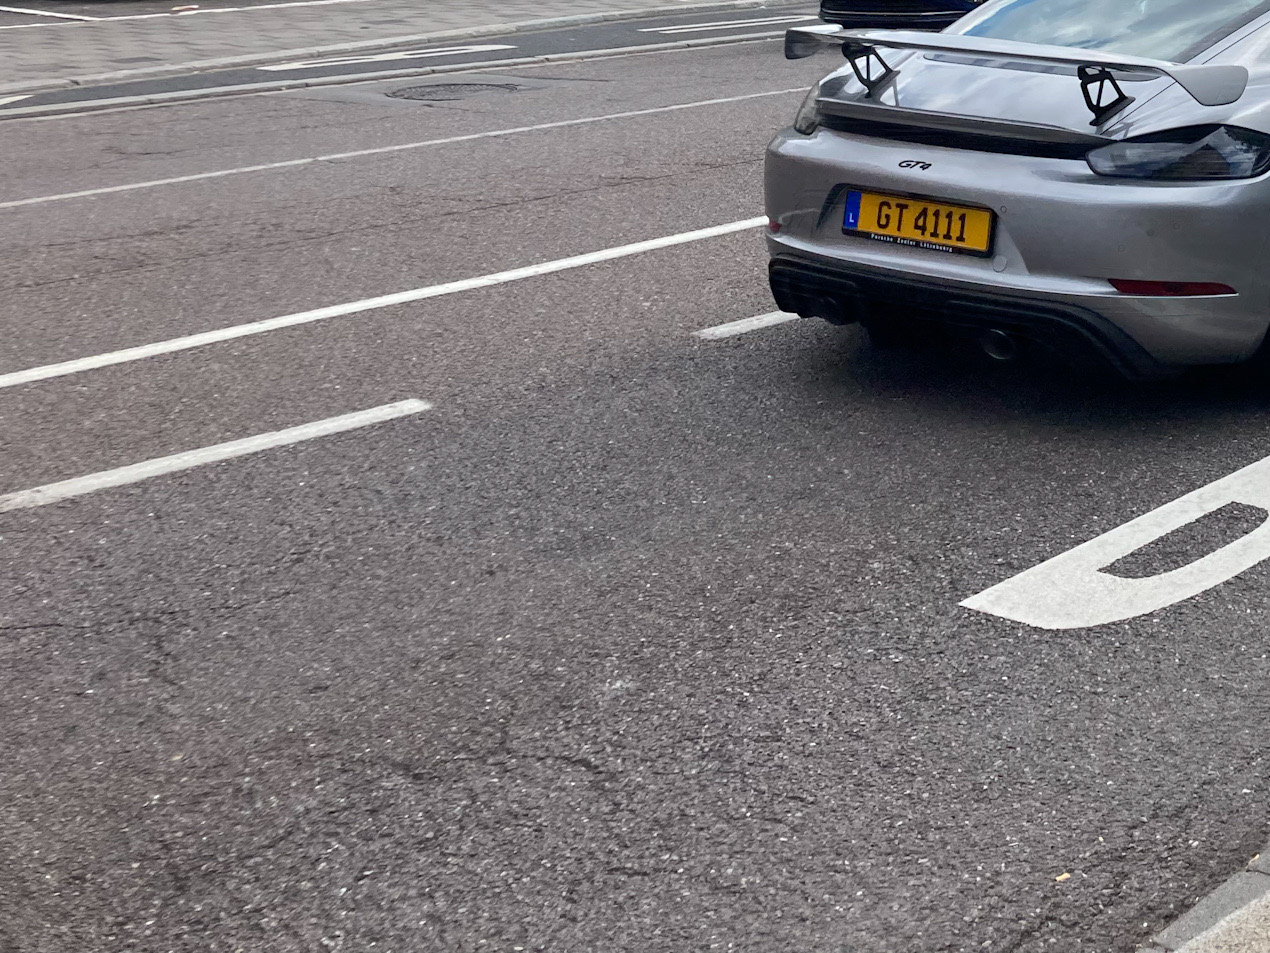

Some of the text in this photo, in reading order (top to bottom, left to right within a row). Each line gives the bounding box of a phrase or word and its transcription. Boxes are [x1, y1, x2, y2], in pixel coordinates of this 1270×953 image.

[898, 160, 932, 171] GT4
[849, 200, 967, 243] L GT 4111
